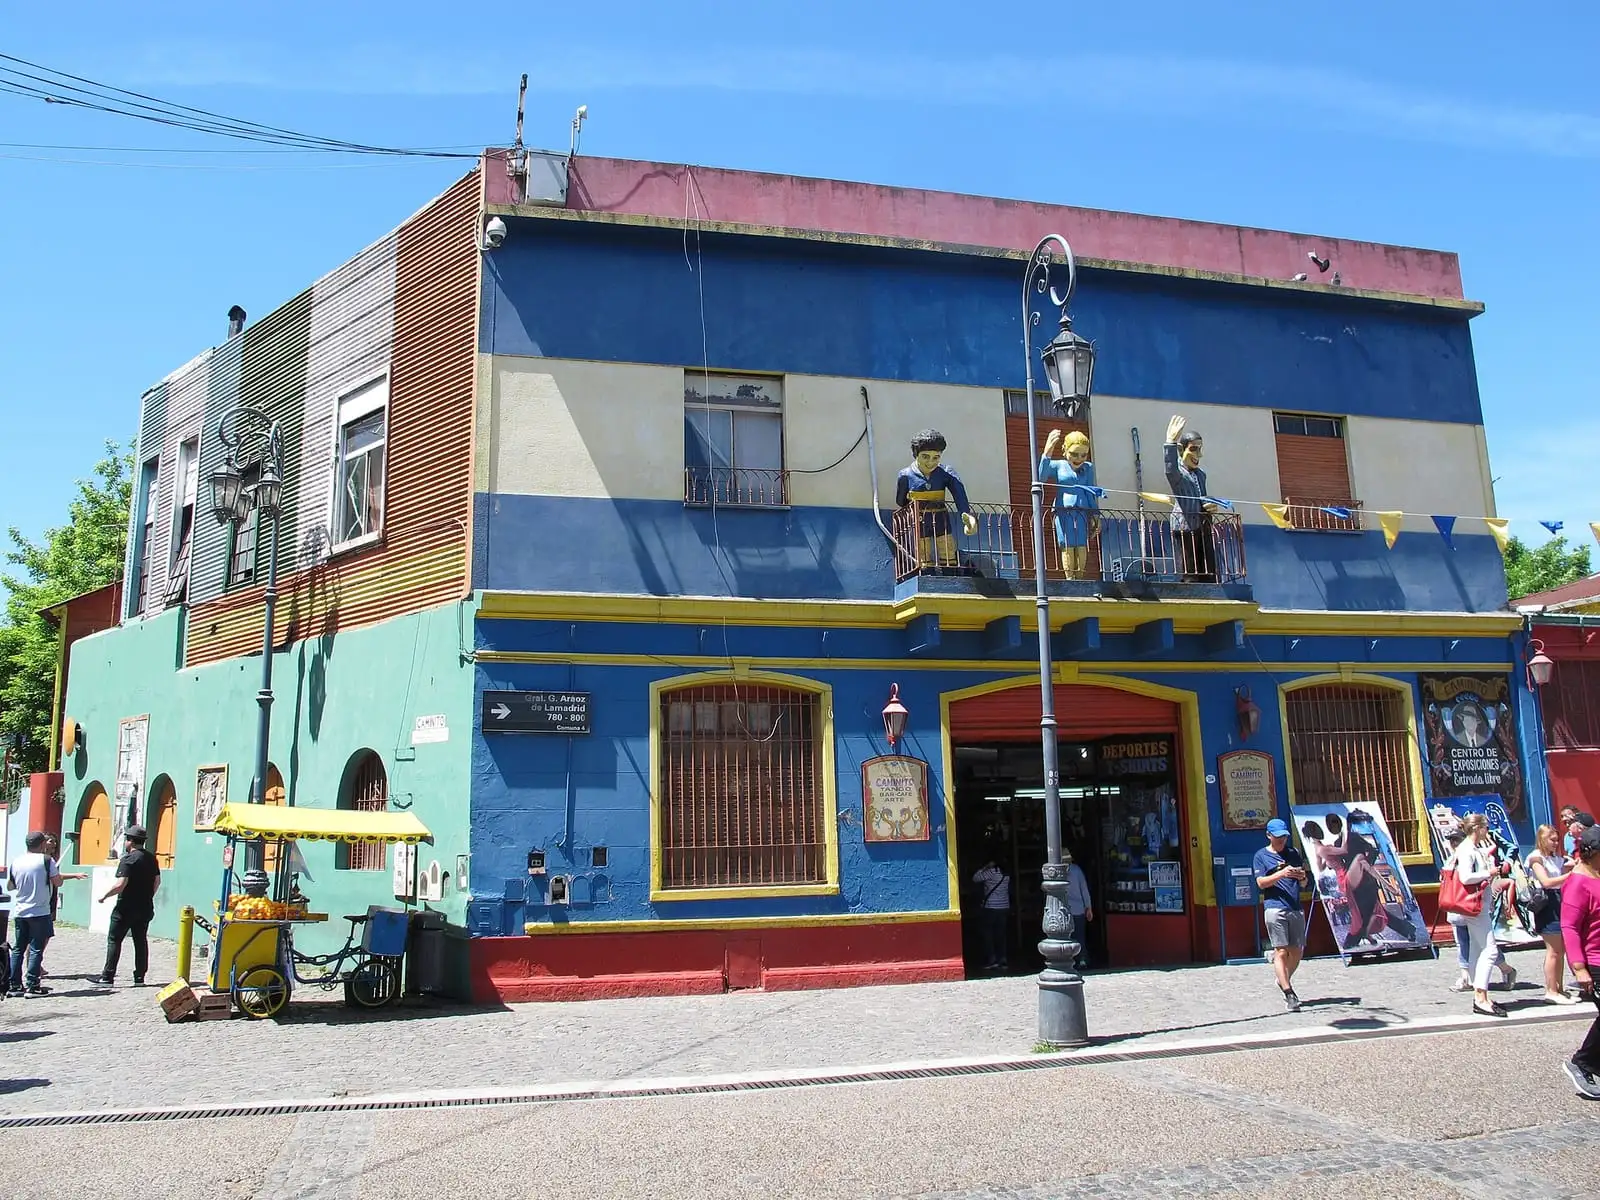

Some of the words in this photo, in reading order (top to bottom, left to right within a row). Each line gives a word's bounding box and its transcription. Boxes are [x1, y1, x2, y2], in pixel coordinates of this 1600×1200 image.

[525, 694, 546, 703] Gral.
[548, 694, 558, 703] G.
[531, 703, 542, 711] de
[544, 703, 586, 712] Lamadrid
[547, 713, 562, 721] 780
[570, 714, 586, 722] 800
[1103, 741, 1168, 758] DEPORTES
[1451, 748, 1484, 758] CENTRO
[1486, 748, 1498, 757] DE
[1452, 758, 1500, 771] EXPOSICIONES
[876, 778, 914, 787] CAMINITO
[1454, 772, 1485, 786] Entrada
[1485, 772, 1501, 785] libre
